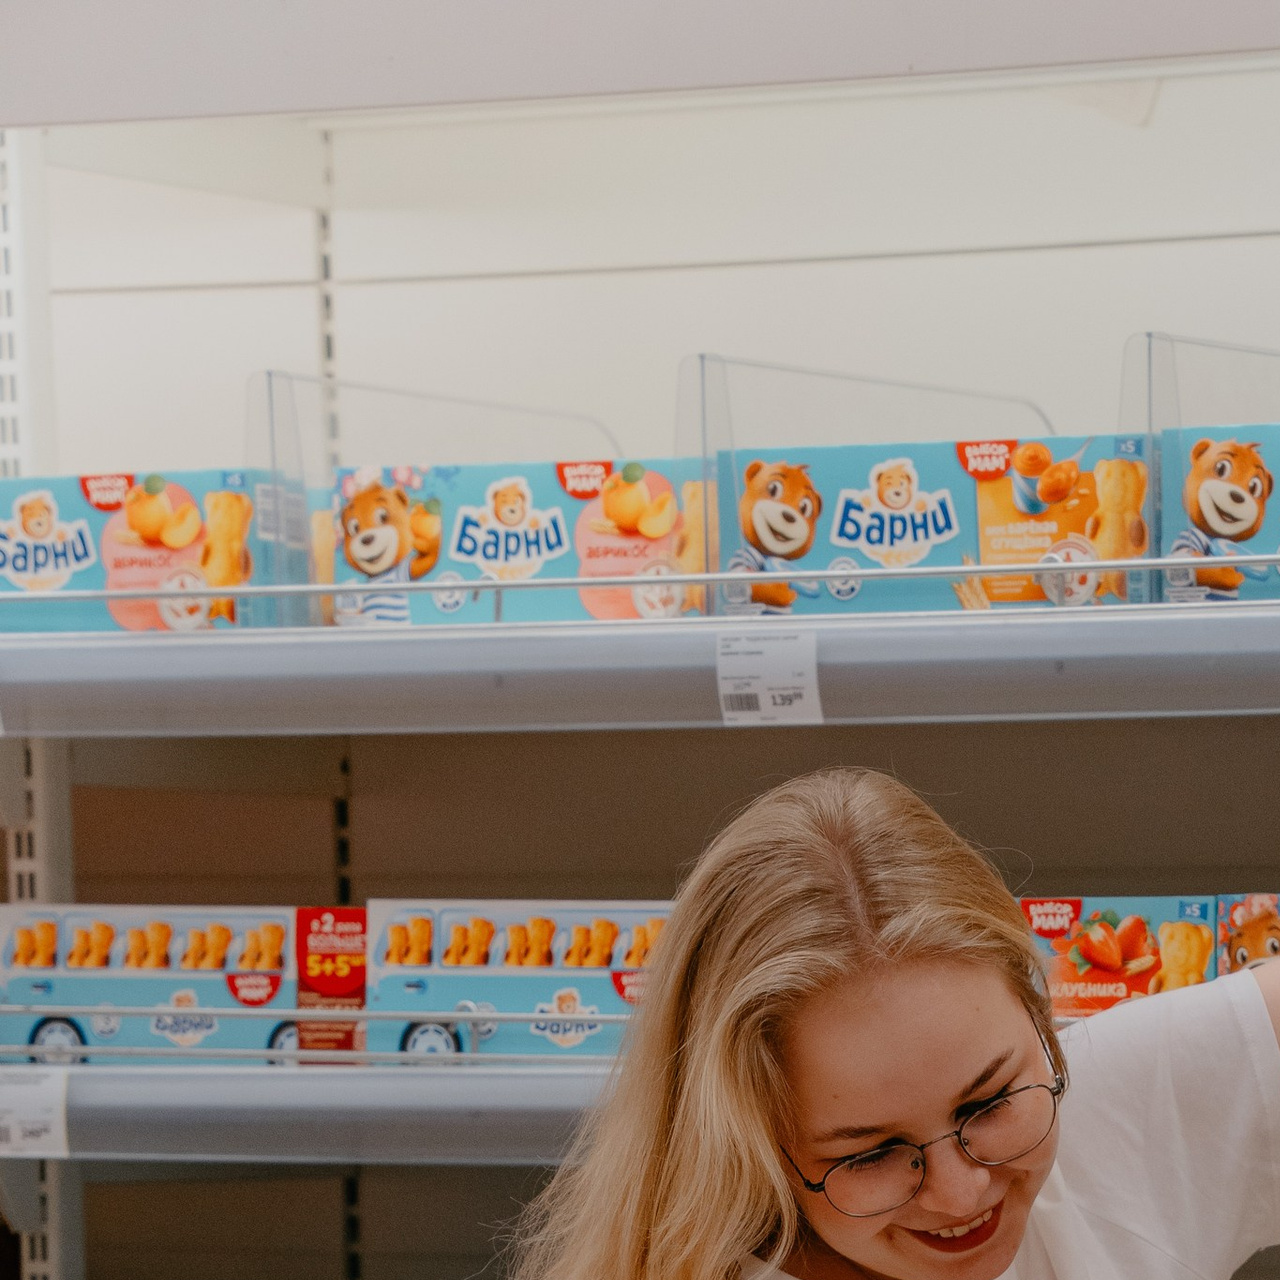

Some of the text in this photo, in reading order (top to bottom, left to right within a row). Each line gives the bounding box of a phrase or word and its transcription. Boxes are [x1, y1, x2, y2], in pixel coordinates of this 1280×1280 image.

[456, 515, 564, 563] Барни
[837, 498, 953, 547] Барни
[0, 529, 90, 574] арни
